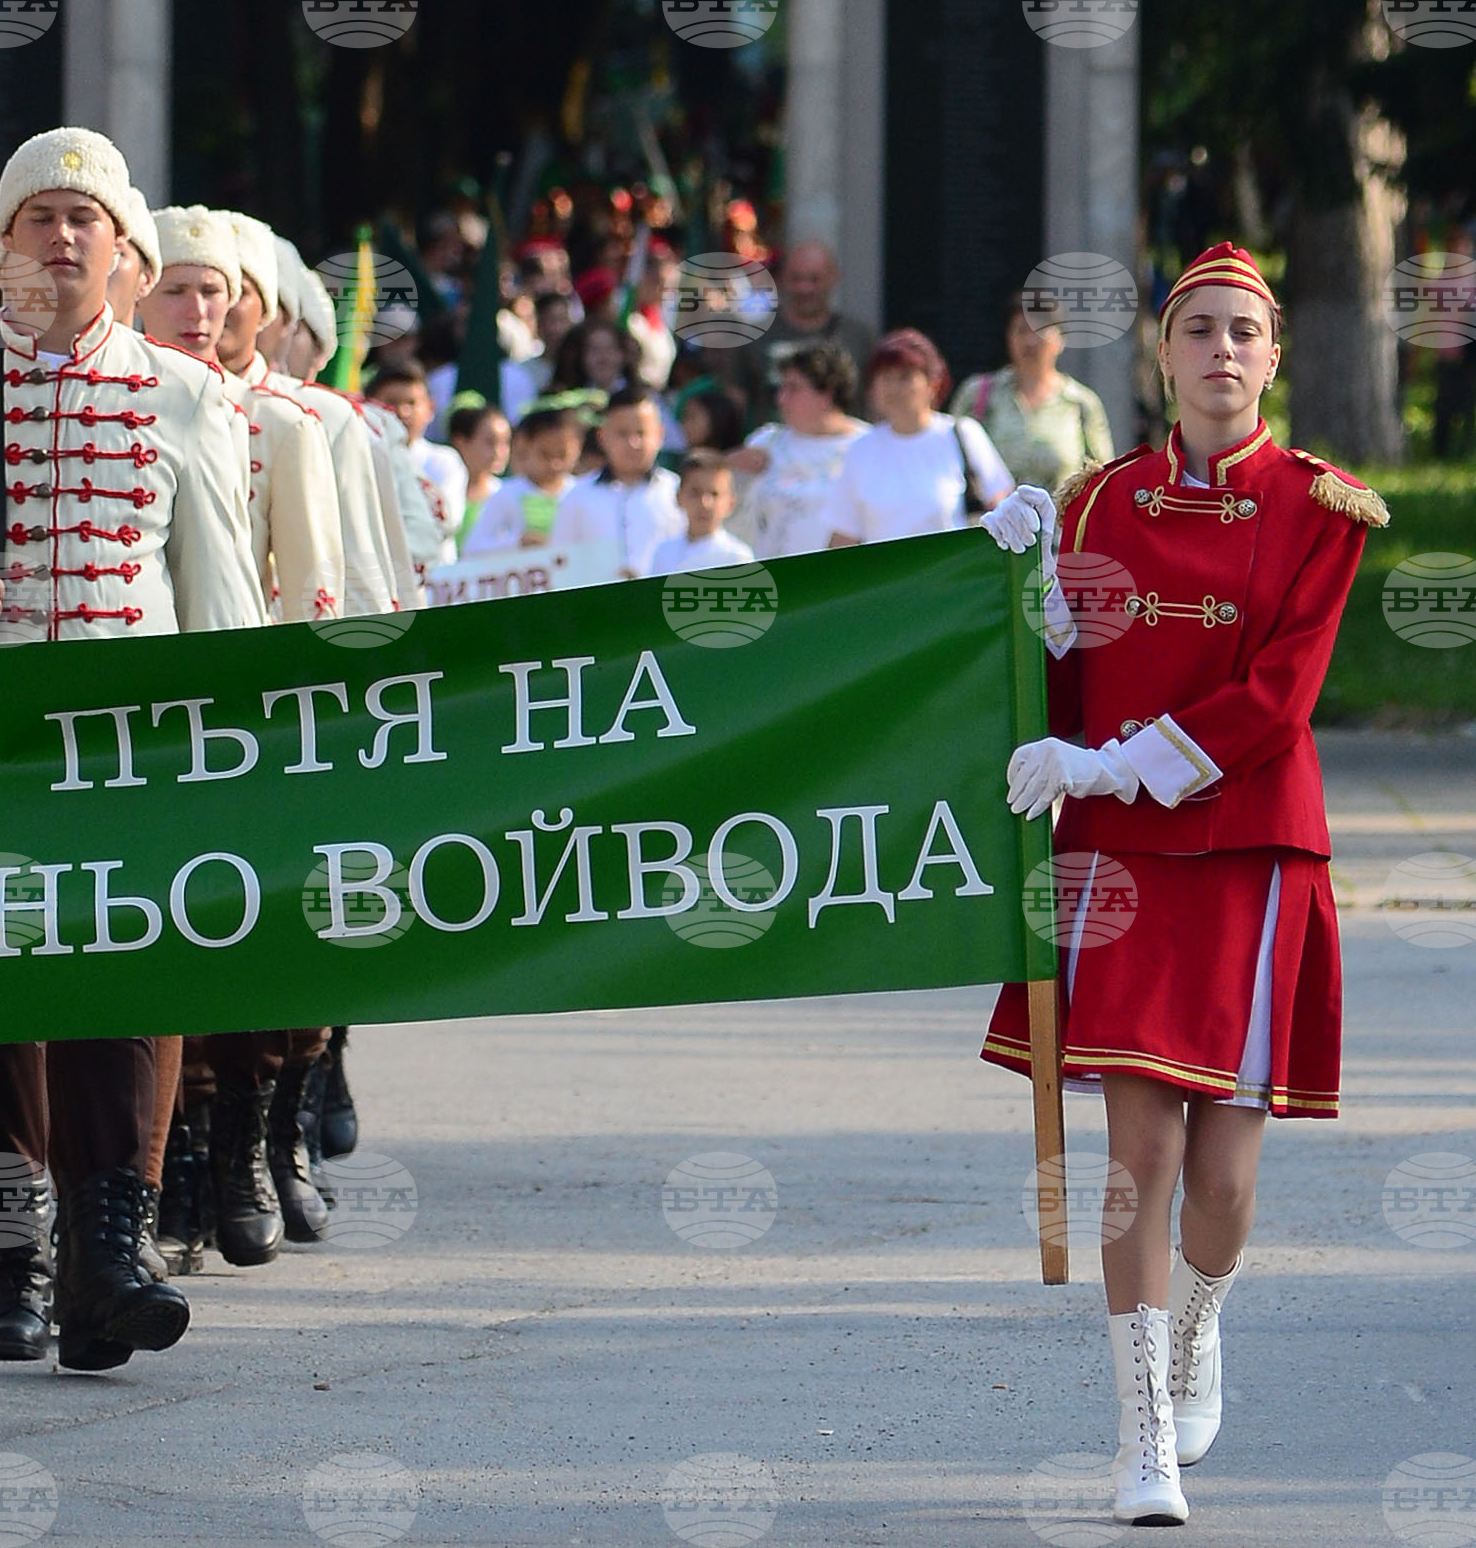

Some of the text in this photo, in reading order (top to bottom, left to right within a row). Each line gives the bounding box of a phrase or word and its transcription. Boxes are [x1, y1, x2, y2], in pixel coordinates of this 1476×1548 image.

[44, 671, 448, 791] ПЪТЯ
[498, 650, 697, 754] НА
[312, 800, 994, 939] ВОЙВОДА
